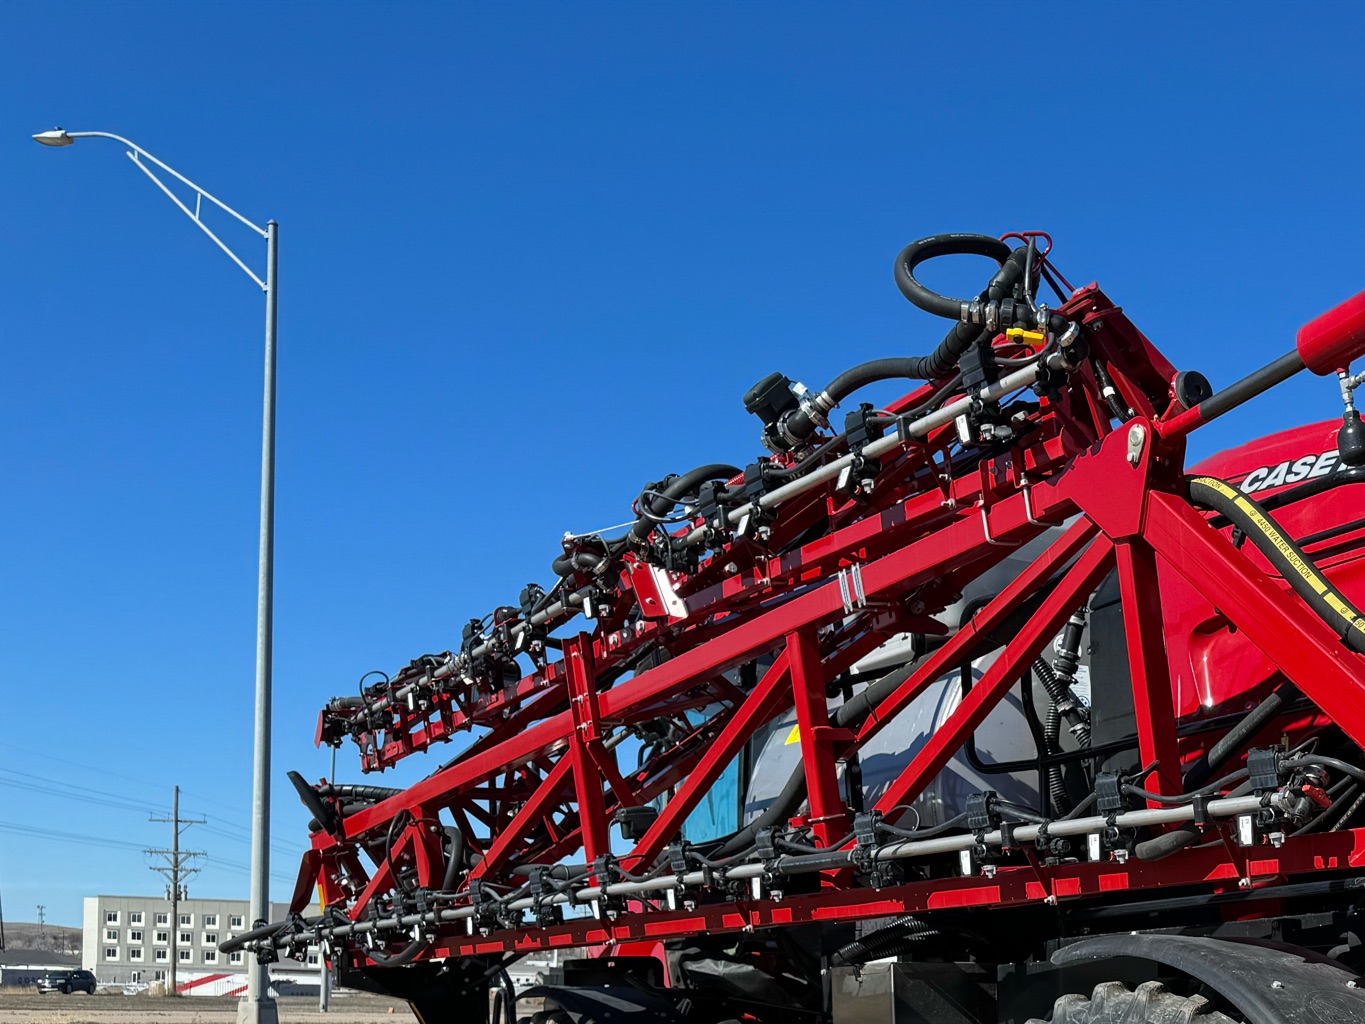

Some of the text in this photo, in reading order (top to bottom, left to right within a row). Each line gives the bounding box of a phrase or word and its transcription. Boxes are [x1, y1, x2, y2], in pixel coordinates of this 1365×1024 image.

[1240, 450, 1339, 494] CASE
[1257, 518, 1313, 579] 4450 WATER SUCTION
